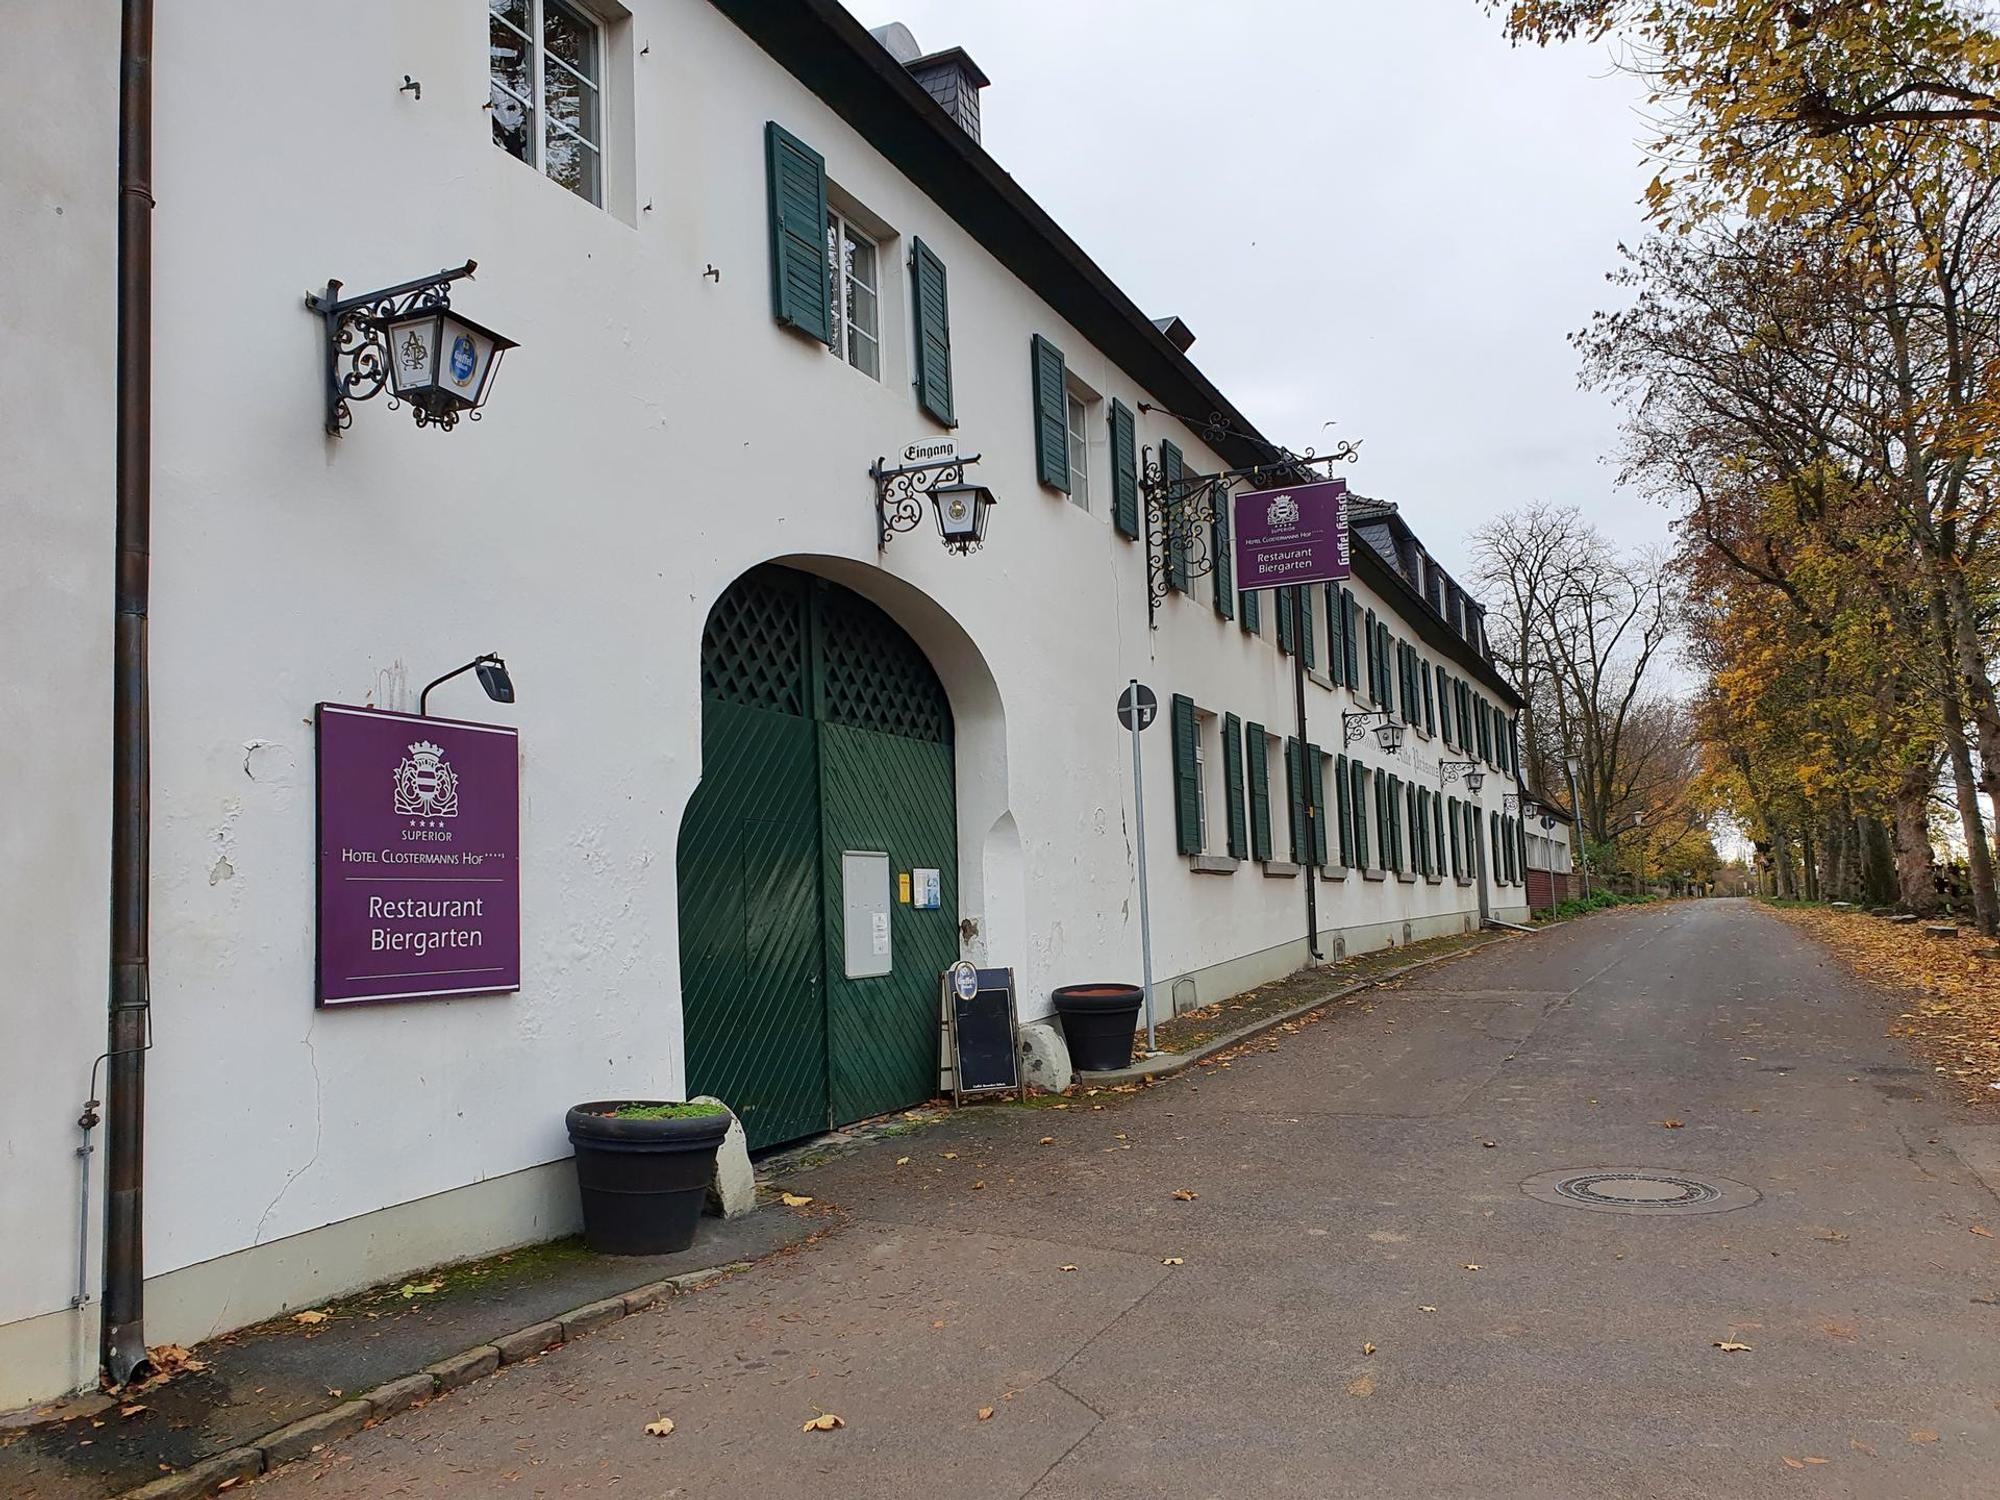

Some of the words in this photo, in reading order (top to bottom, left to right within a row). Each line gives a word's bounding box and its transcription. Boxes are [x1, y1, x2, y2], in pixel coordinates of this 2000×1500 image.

[904, 443, 954, 460] Eingang
[1335, 492, 1348, 530] Kölsch
[1257, 548, 1312, 562] Restaurant
[1336, 530, 1350, 566] Gaffel
[1259, 560, 1312, 573] Biergarten
[401, 829, 453, 842] SUPERIOR
[368, 896, 484, 919] Restaurant
[371, 928, 483, 956] Biergarten
